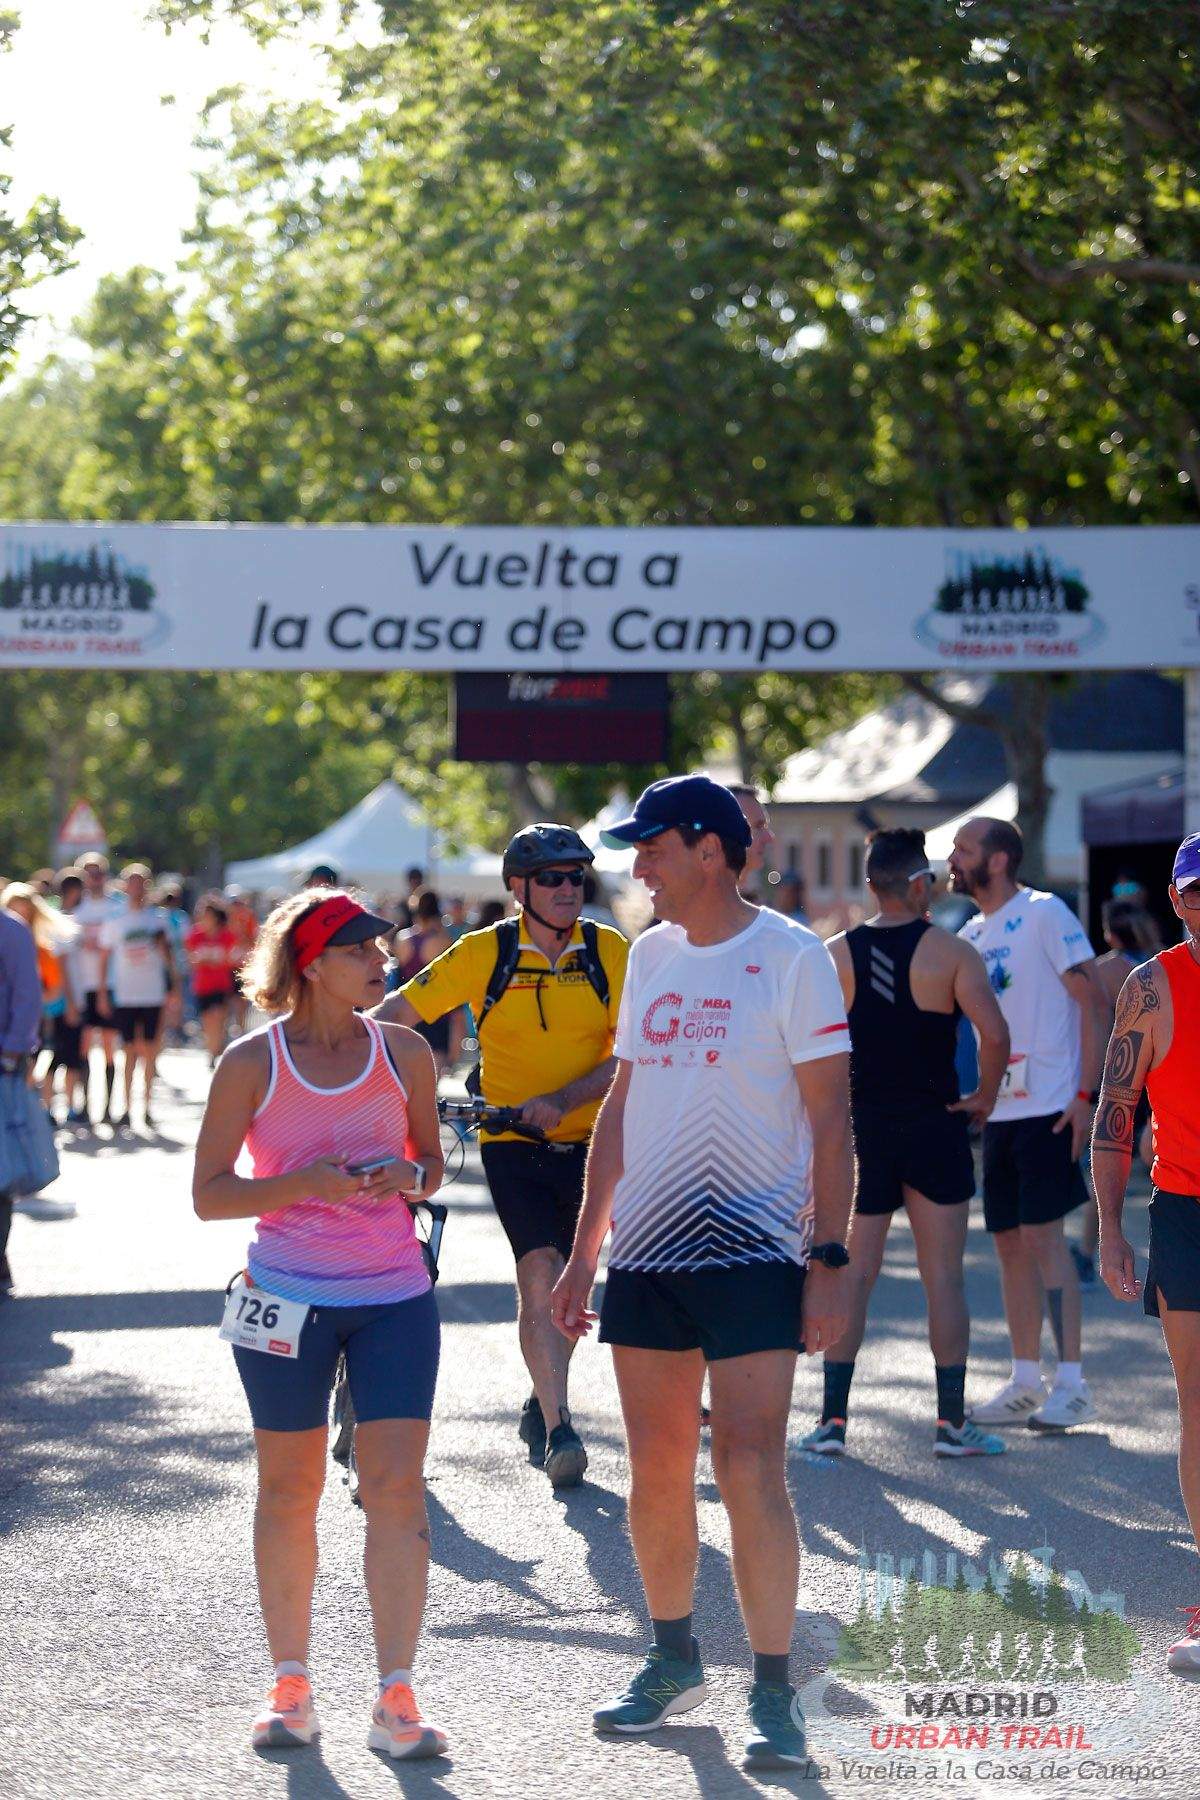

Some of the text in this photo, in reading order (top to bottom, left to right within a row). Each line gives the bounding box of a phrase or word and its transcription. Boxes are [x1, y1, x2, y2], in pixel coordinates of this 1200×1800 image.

[410, 541, 680, 588] Vuelta a
[252, 602, 838, 663] la Casa de Campo
[702, 998, 732, 1010] MBA
[683, 1021, 727, 1042] Gijón
